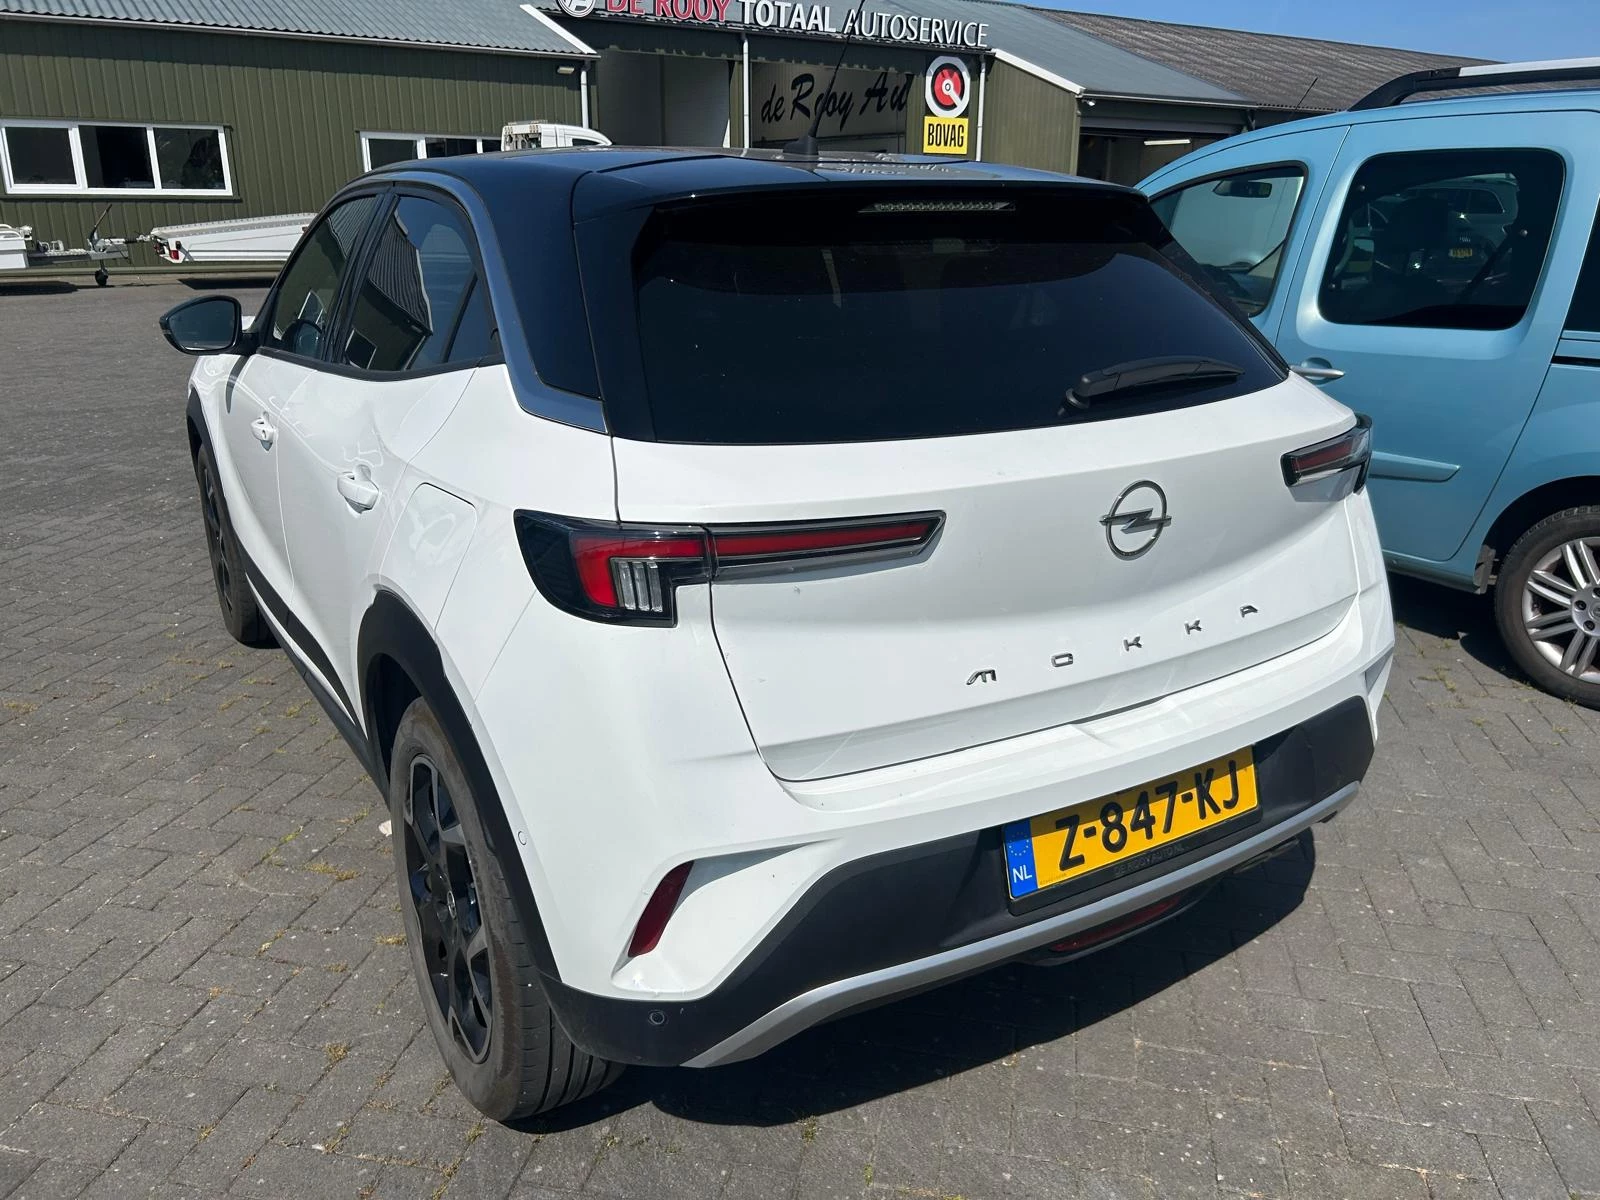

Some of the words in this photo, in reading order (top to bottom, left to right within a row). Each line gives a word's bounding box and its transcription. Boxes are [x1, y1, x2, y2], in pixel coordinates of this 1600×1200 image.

[656, 0, 729, 22] ROOY
[738, 0, 837, 33] TOTAAL
[843, 8, 989, 47] AUTOSERVICE
[761, 83, 785, 124] de
[927, 123, 965, 148] BOVAG
[966, 604, 1258, 685] MOKKA
[1055, 760, 1240, 872] Z-847-KJ
[1012, 864, 1033, 883] NL
